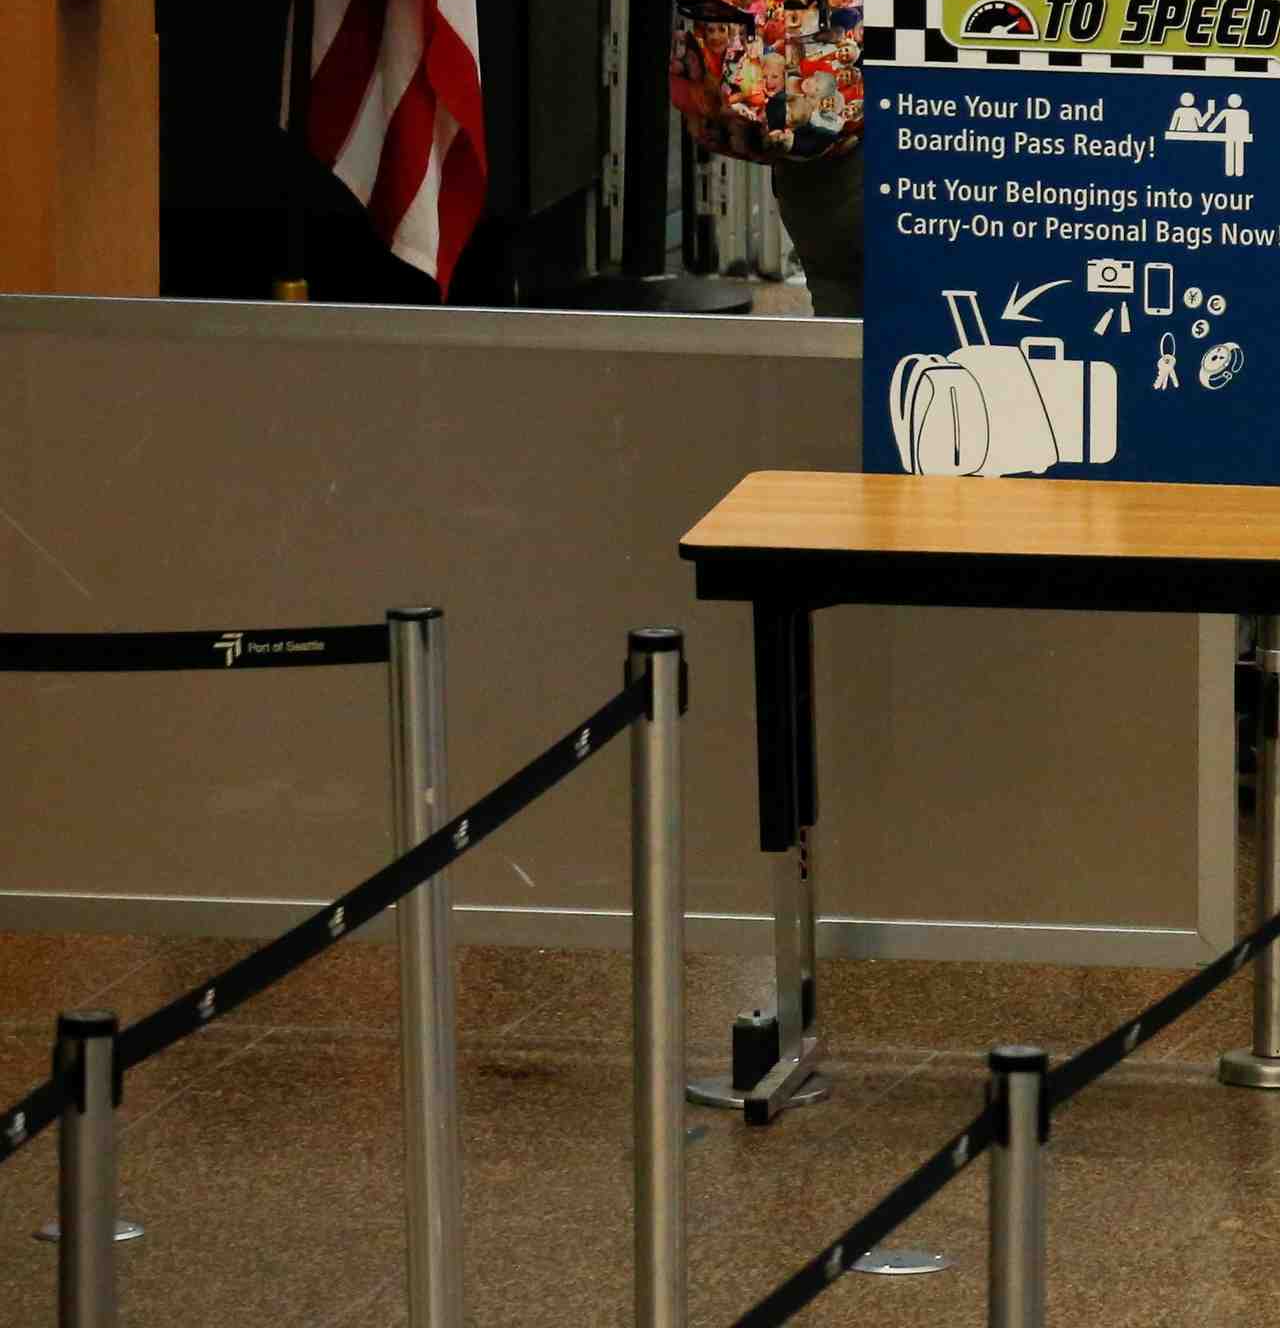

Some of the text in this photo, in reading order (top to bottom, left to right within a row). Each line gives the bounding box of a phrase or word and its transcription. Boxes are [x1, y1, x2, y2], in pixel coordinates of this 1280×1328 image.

[898, 94, 1104, 122] Have Your ID and
[898, 128, 1156, 163] Boarding Pass Ready!
[898, 178, 1254, 215] Put Your Belongings into your
[897, 213, 1004, 241] Carry-On
[1012, 220, 1038, 238] or
[1046, 218, 1147, 243] Personal
[1156, 222, 1212, 249] Bags
[248, 641, 325, 652] Port of Seattle
